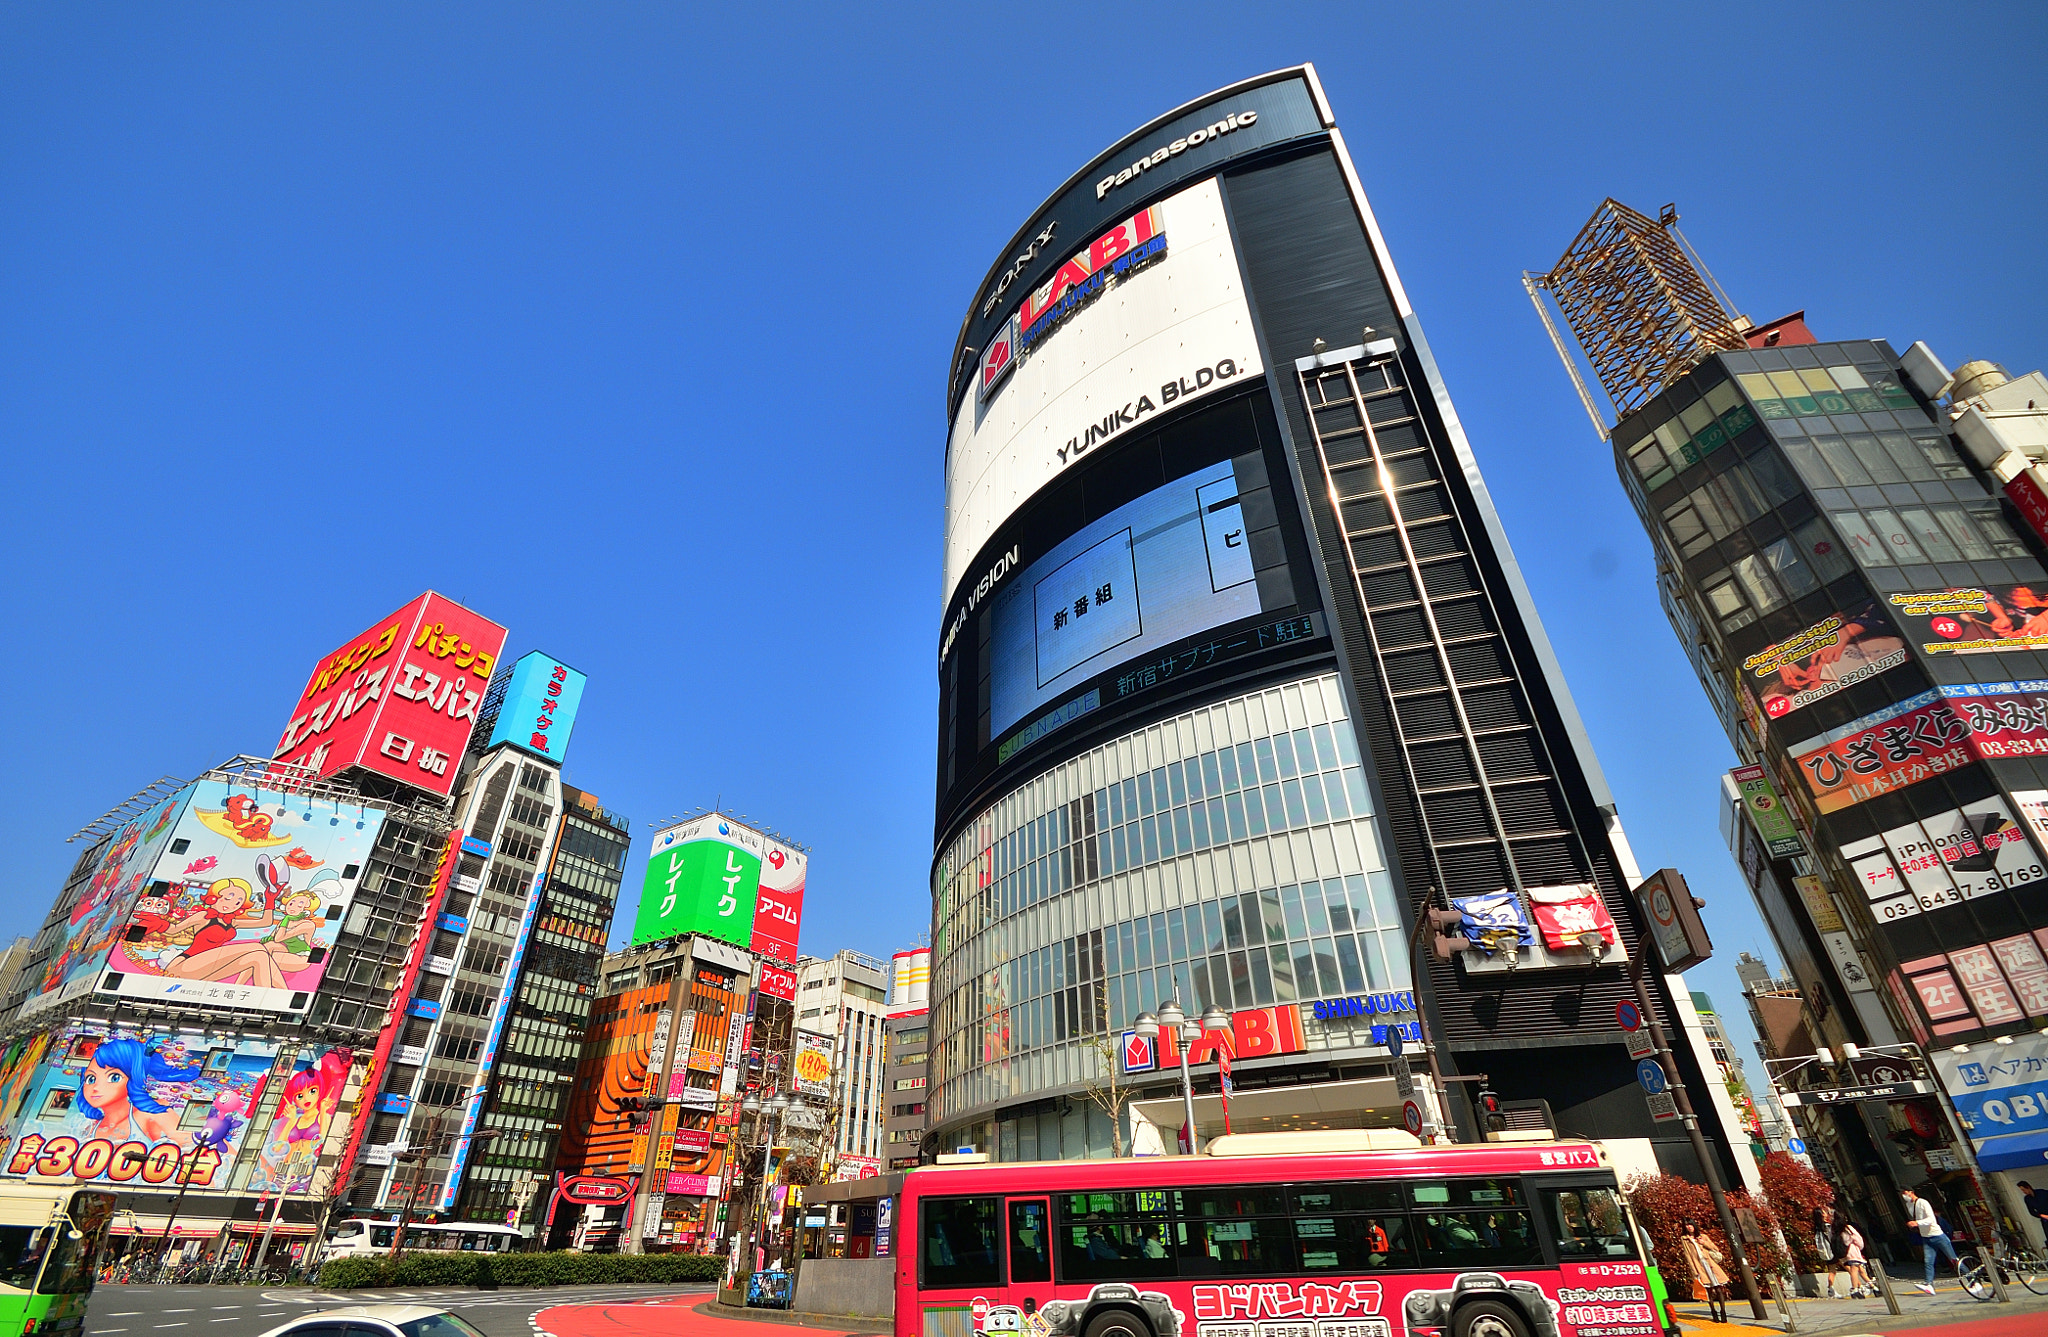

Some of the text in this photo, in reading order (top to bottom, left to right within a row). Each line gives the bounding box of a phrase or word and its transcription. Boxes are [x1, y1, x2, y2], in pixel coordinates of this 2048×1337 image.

[1096, 109, 1259, 200] Panasonic
[983, 219, 1059, 320] SONY
[1019, 202, 1164, 334] LABI
[1021, 235, 1168, 349] SHINJUKU 東口館
[1056, 358, 1245, 466] YUNIKA BLDG.
[1224, 528, 1243, 549] ピ
[968, 543, 1019, 612] VISION
[1891, 589, 1987, 606] Japanese-style
[1052, 582, 1114, 632] 新番組
[1904, 601, 1986, 615] ear cleaning
[1937, 622, 1956, 633] 4F
[307, 620, 402, 699] パチンコ
[414, 621, 495, 680] パチンコ
[1744, 616, 1841, 670] Japanese-style
[1755, 631, 1839, 678] ear cleaning
[393, 662, 481, 726] エスパス
[1769, 650, 1905, 715] 4F 30min 3200JPY
[274, 663, 392, 760] エスパス
[999, 692, 1096, 762] SUBNADE
[380, 730, 450, 776] 日拓
[1848, 747, 1970, 804] 山本耳かき店
[1746, 780, 1765, 792] 4F
[1897, 826, 1974, 859] iPhone
[1943, 826, 2026, 863] 即日修理
[659, 852, 684, 918] レイク
[718, 850, 743, 917] レイク
[1883, 863, 2045, 920] 03-6457-8769
[759, 896, 798, 926] アコム
[768, 942, 781, 955] 3F
[1957, 940, 2041, 984] 快適
[208, 987, 252, 1001] 北電子
[762, 968, 796, 990] アイフル
[1921, 986, 1956, 1008] 2F
[1977, 973, 2048, 1021] 生活
[1158, 1003, 1307, 1069] LABI
[801, 1054, 827, 1075] 190円
[1642, 1069, 1653, 1091] P
[1817, 1091, 1839, 1101] モア
[1539, 1151, 1596, 1166] 都営バス
[879, 1203, 886, 1225] P
[856, 1242, 864, 1256] 4
[1601, 1264, 1641, 1276] D-Z529
[1194, 1281, 1382, 1317] ヨドバシカメラ
